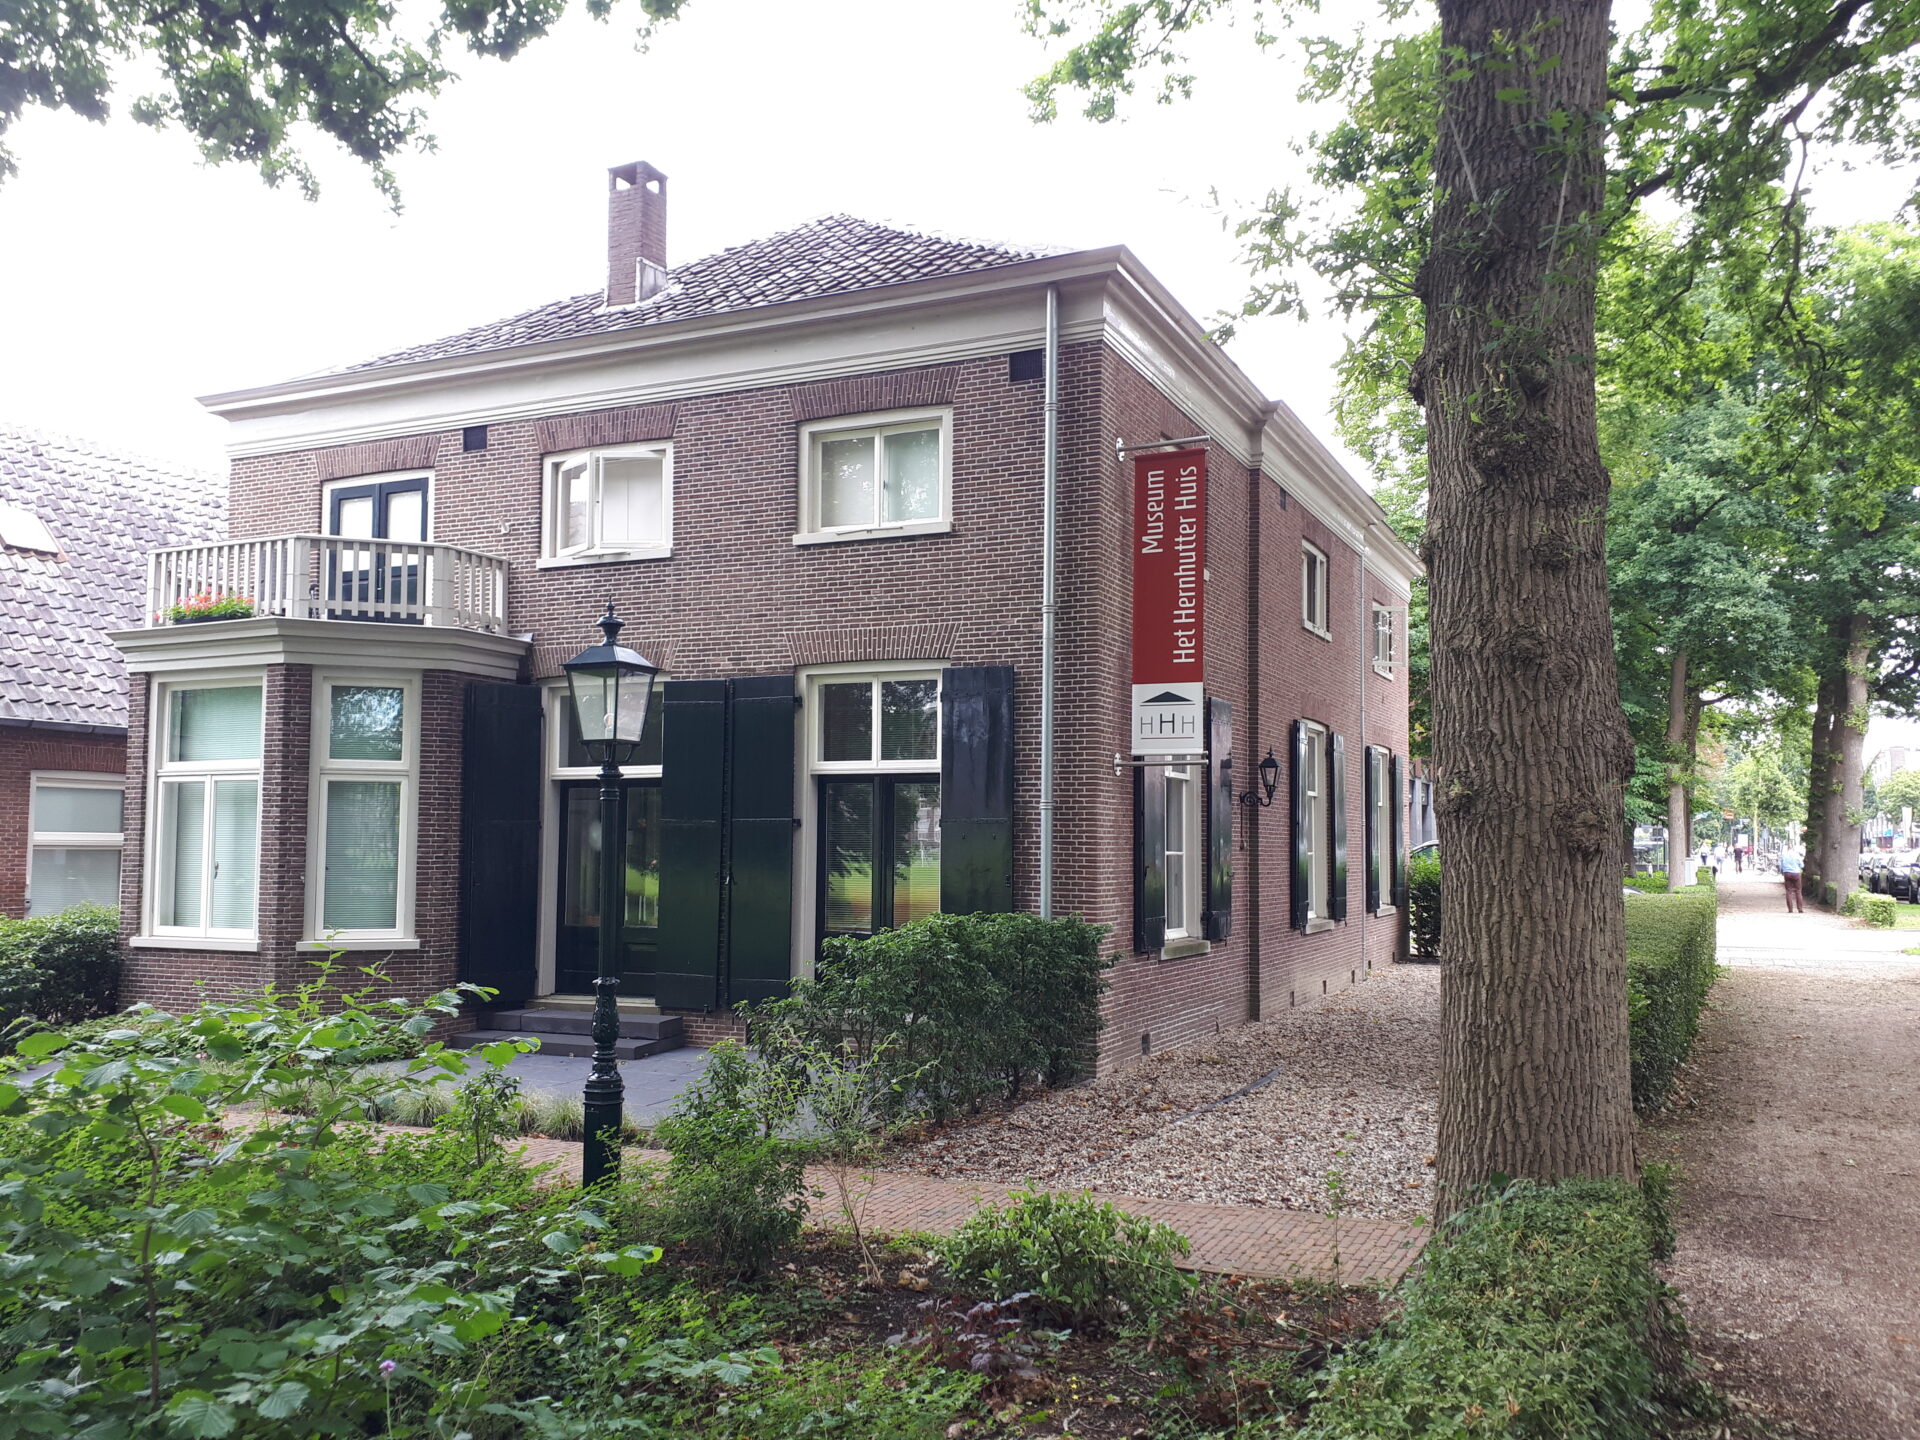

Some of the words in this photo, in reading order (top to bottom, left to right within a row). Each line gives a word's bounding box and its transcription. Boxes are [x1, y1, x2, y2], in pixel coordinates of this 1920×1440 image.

[1141, 470, 1164, 554] Museum
[1175, 465, 1197, 509] Huis
[1173, 516, 1197, 624] Hernhutter
[1172, 629, 1196, 663] Het
